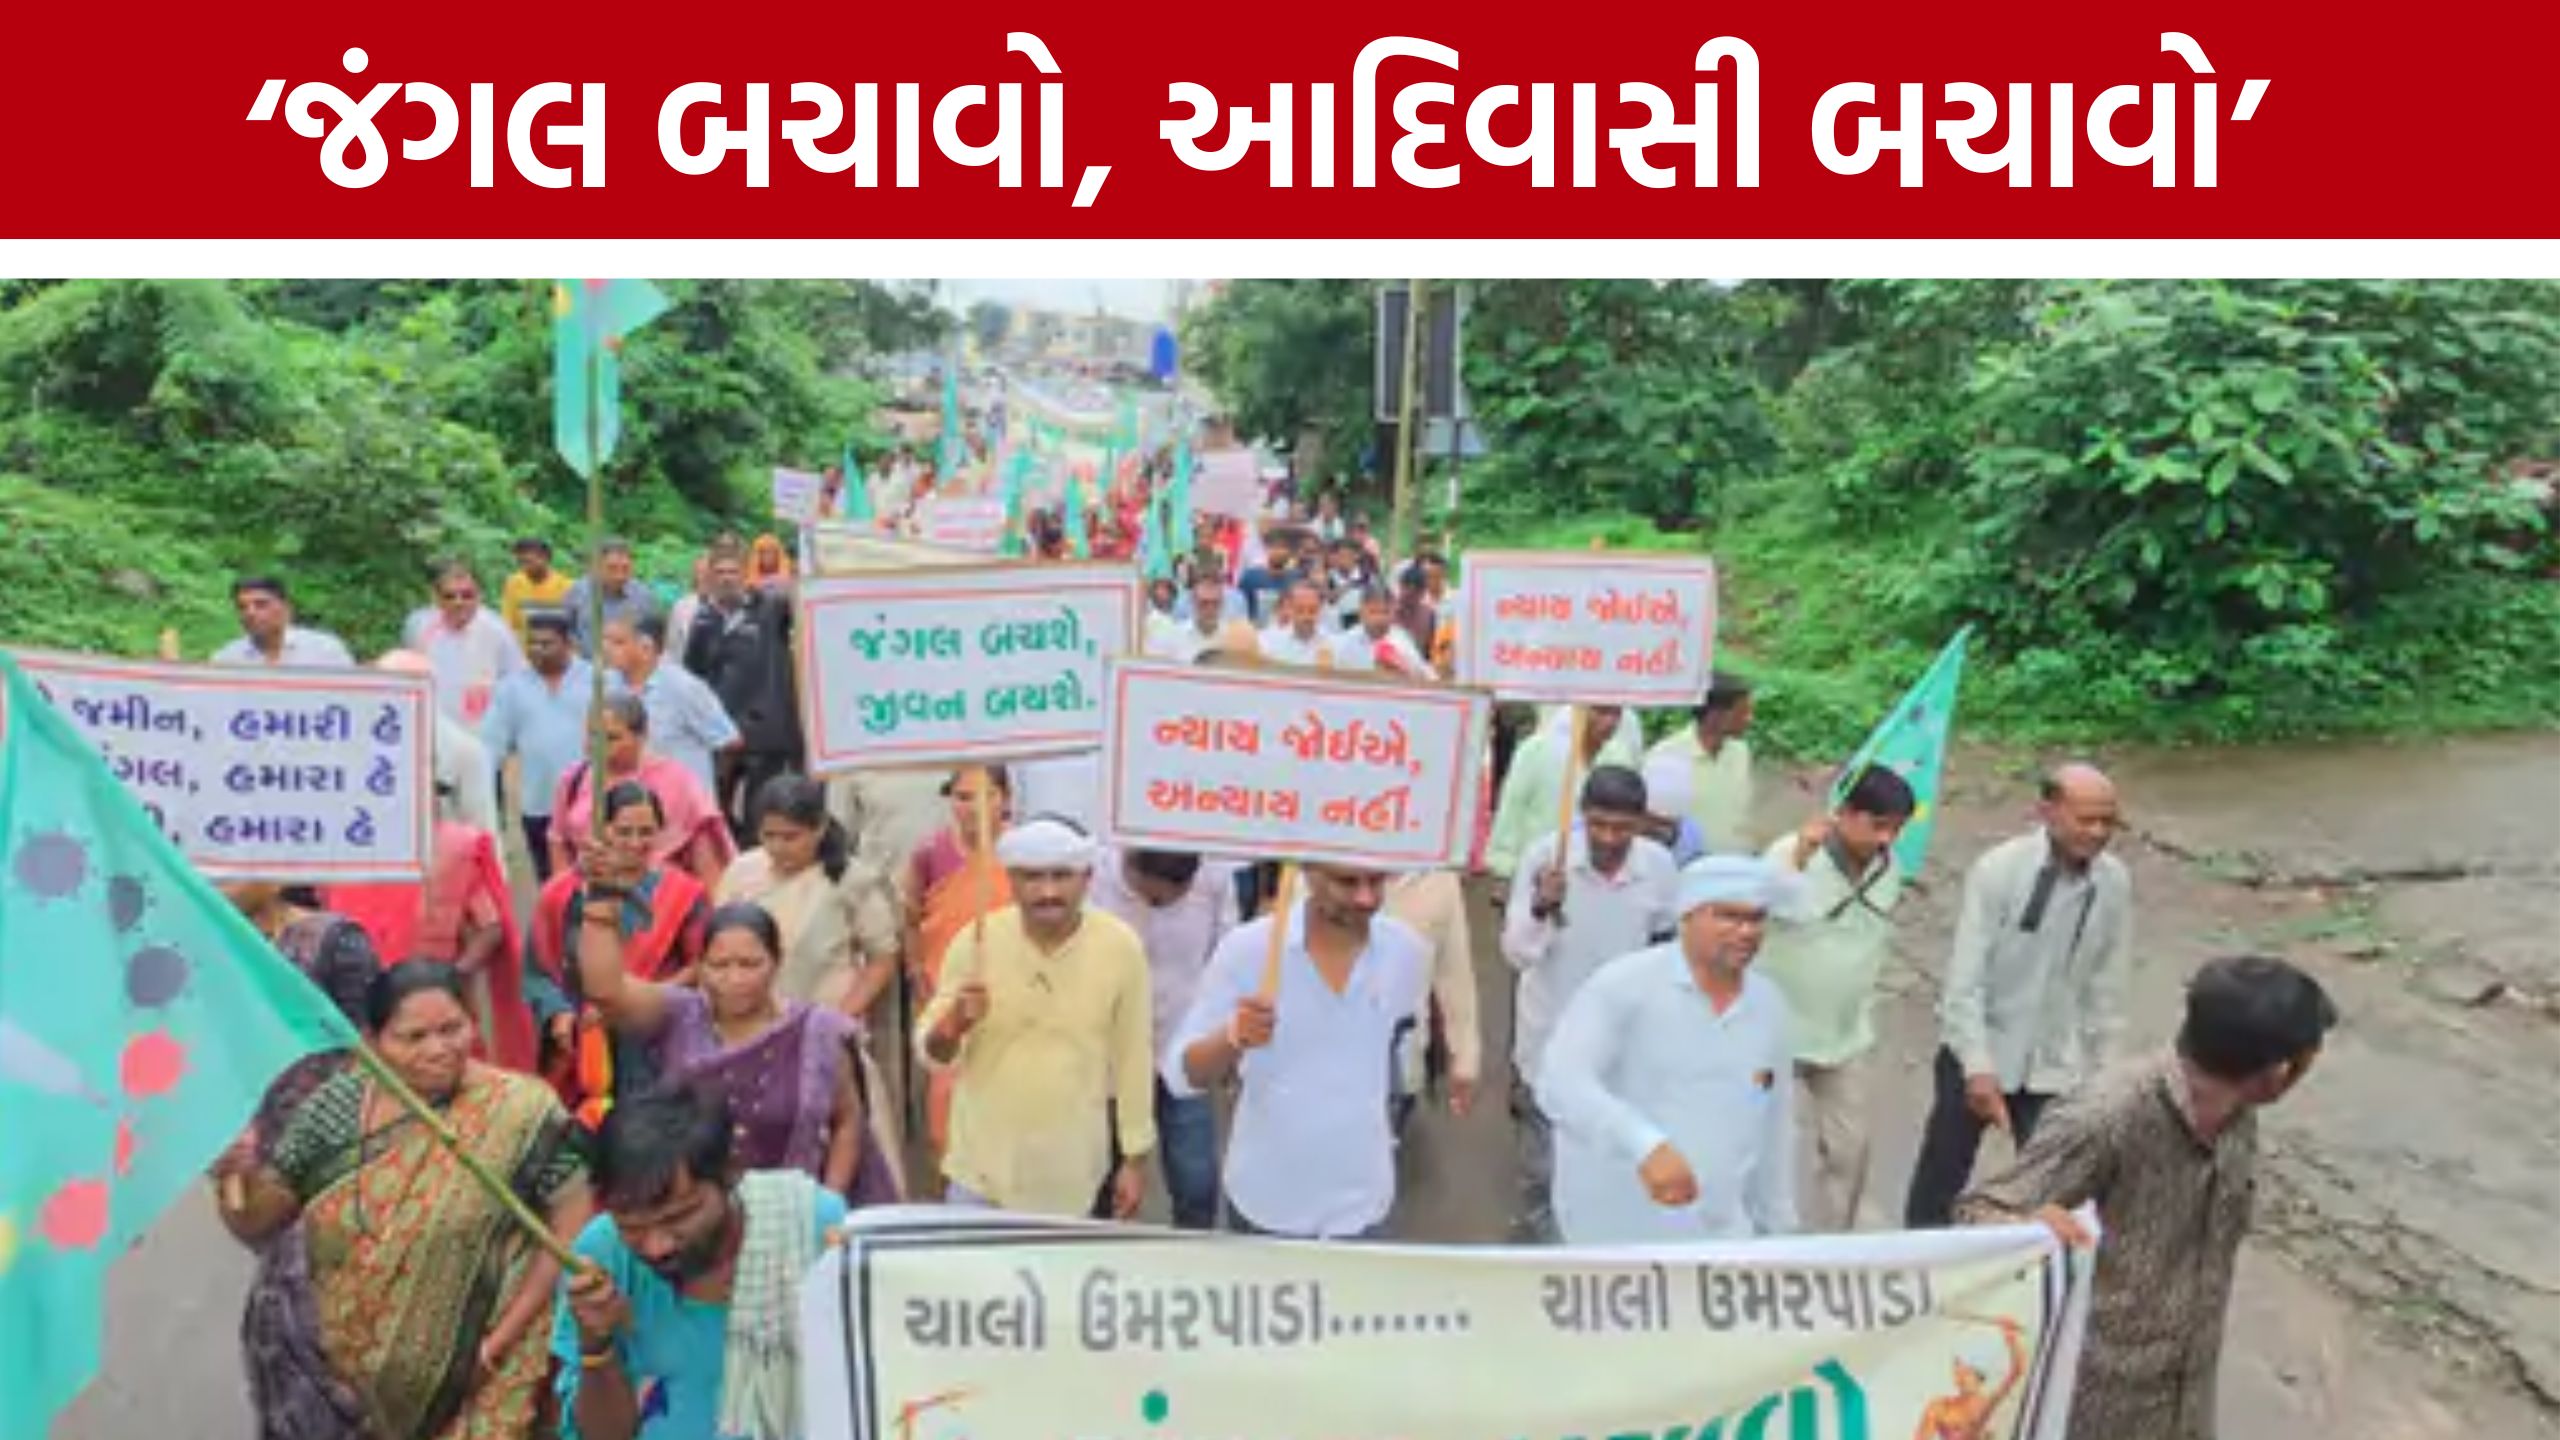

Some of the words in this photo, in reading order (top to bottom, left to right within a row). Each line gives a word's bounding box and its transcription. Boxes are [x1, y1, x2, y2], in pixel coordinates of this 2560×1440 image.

[850, 612, 962, 660] જંગલ
[979, 604, 1096, 657] બચશે,
[71, 693, 203, 742] જમીન,
[229, 703, 352, 742] હમારી
[857, 688, 967, 733] જીવન
[984, 667, 1097, 720] બચશે.
[1154, 715, 1259, 754] ન્યાય
[1281, 710, 1423, 777] જોઈએ,
[224, 763, 345, 795] હમારા
[1147, 779, 1300, 822] અન્યાય
[205, 814, 323, 845] હમારા
[904, 1267, 1047, 1351] ચાલો
[1540, 1262, 1670, 1332] ચાલો
